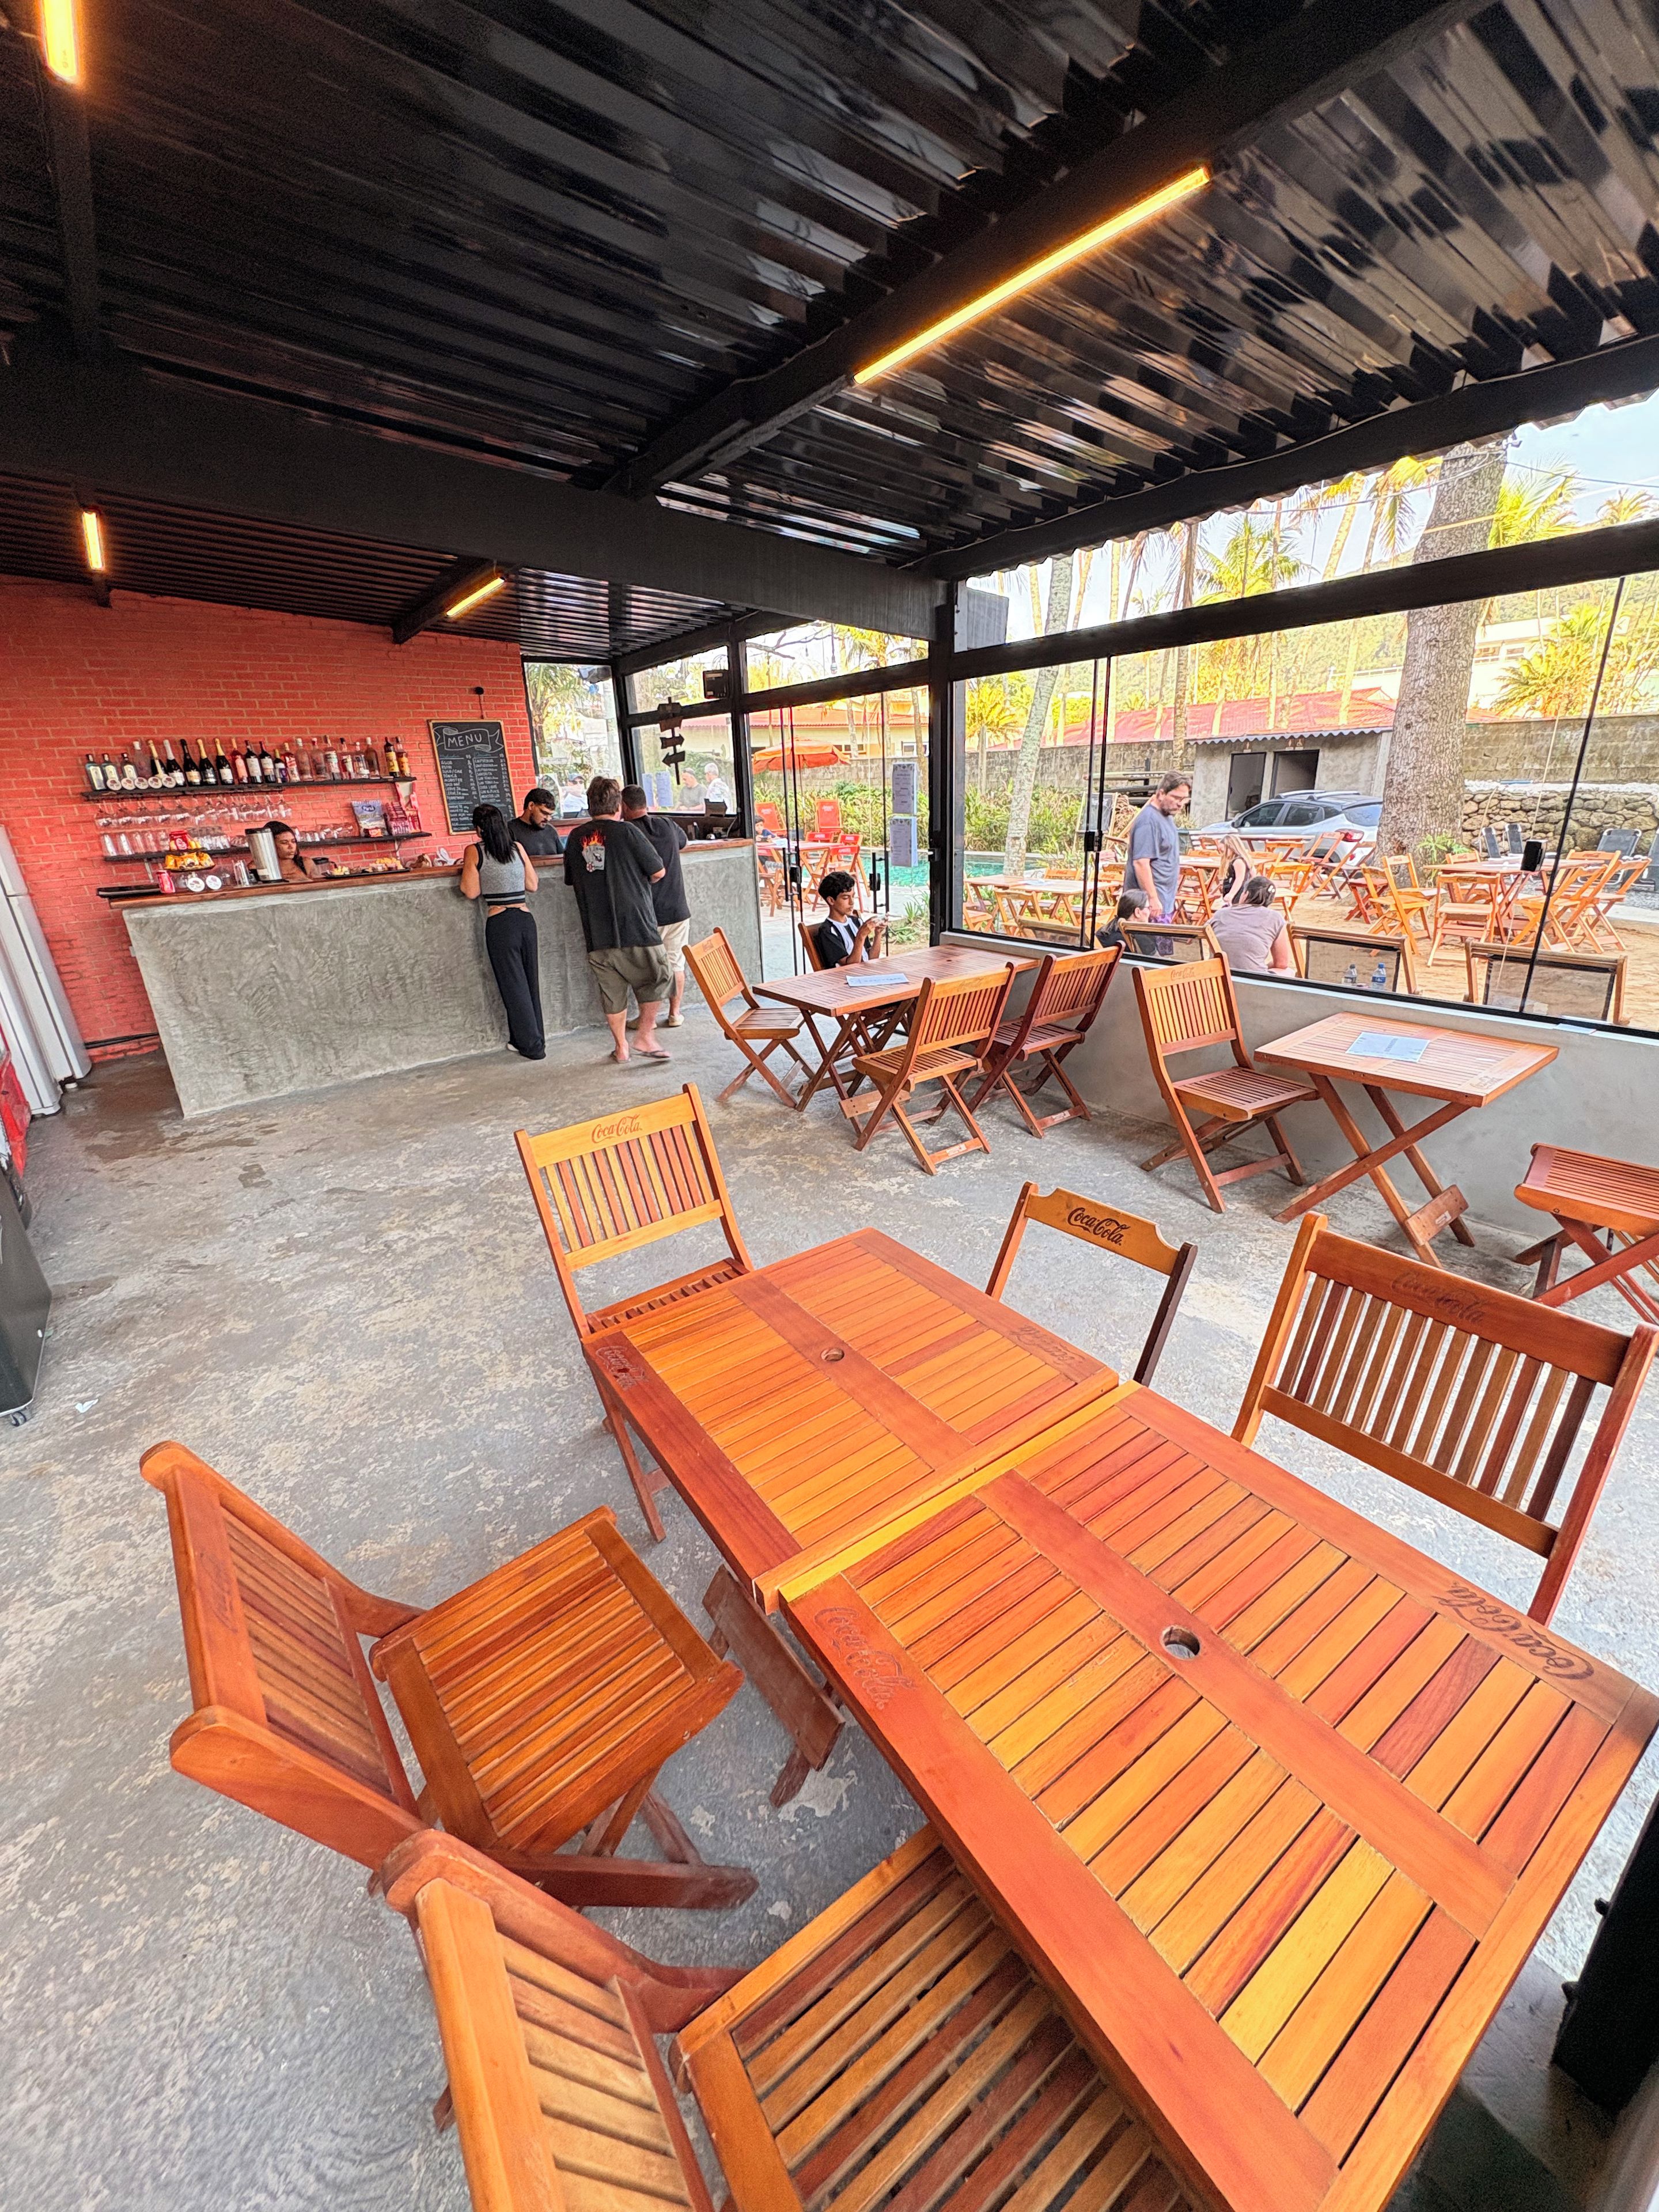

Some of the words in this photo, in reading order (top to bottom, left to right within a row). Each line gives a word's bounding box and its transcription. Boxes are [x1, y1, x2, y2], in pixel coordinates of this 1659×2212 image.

[448, 733, 482, 747] MENU
[591, 1114, 643, 1144] Coca-Cola
[1067, 1207, 1131, 1246] Coca-Cola
[1432, 1581, 1595, 1680] Coca-Cola
